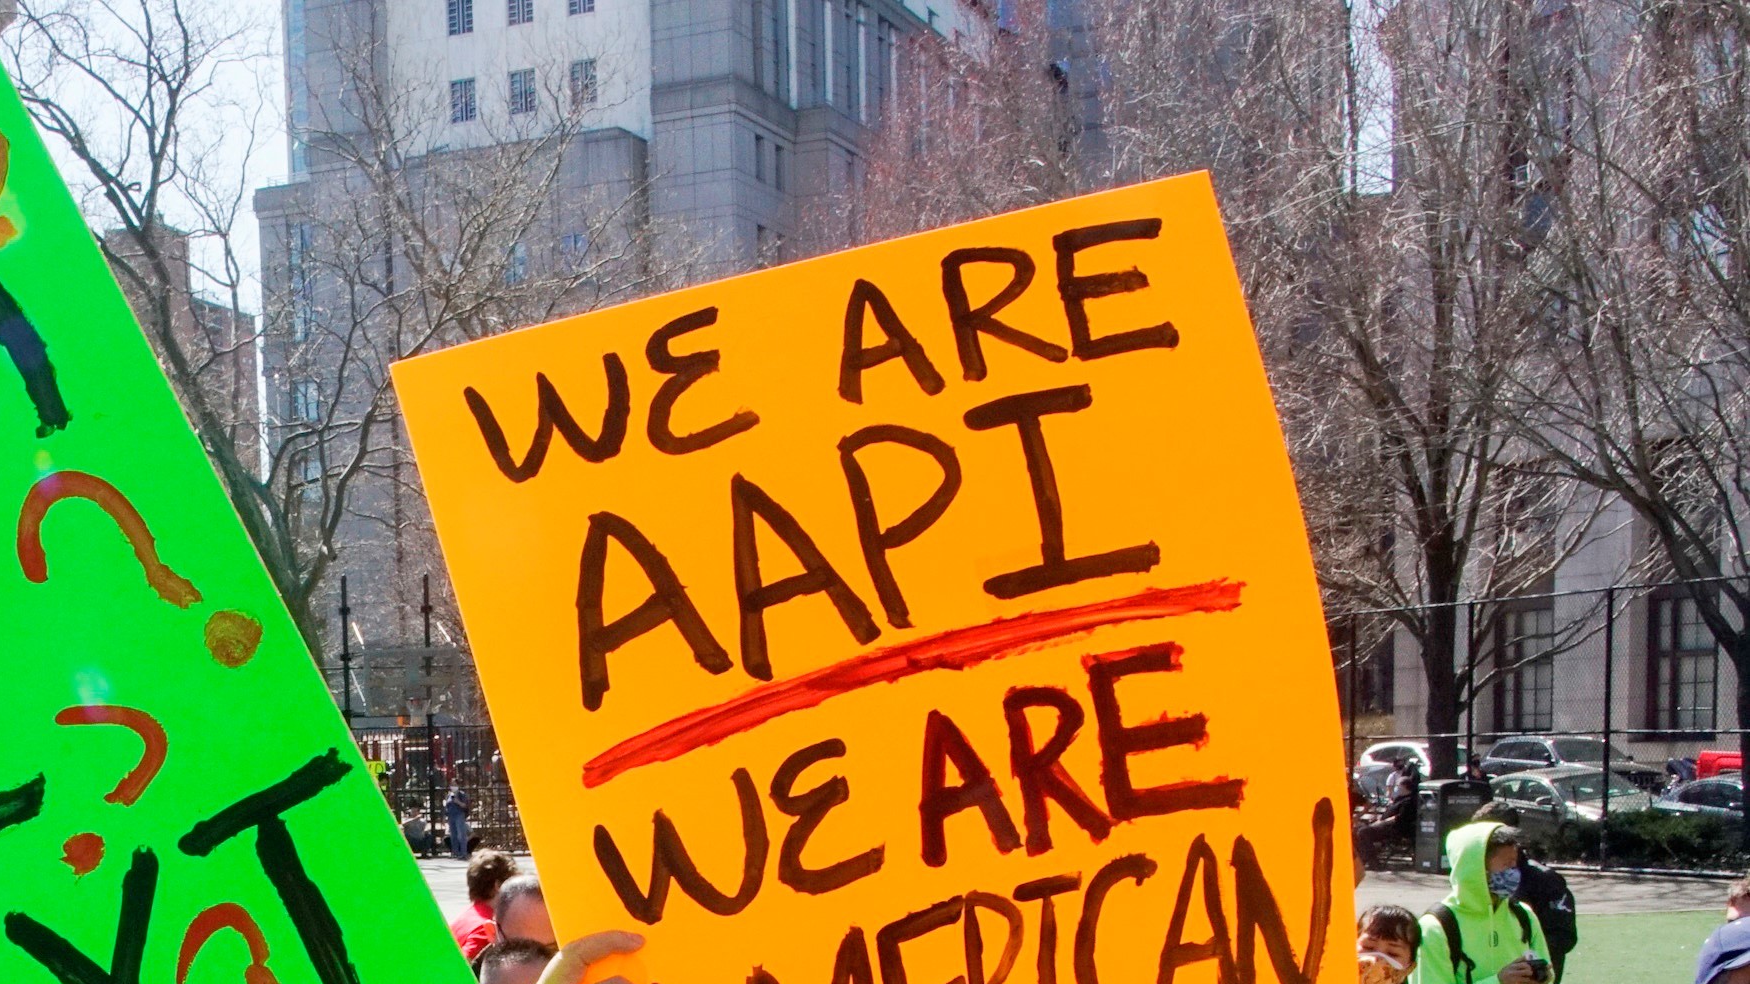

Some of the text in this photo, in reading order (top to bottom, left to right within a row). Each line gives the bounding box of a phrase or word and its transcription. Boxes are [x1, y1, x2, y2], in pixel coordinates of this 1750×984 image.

[463, 217, 1179, 483] WE ARE
[575, 383, 1160, 712] AAPI
[594, 642, 1246, 926] WE ARE
